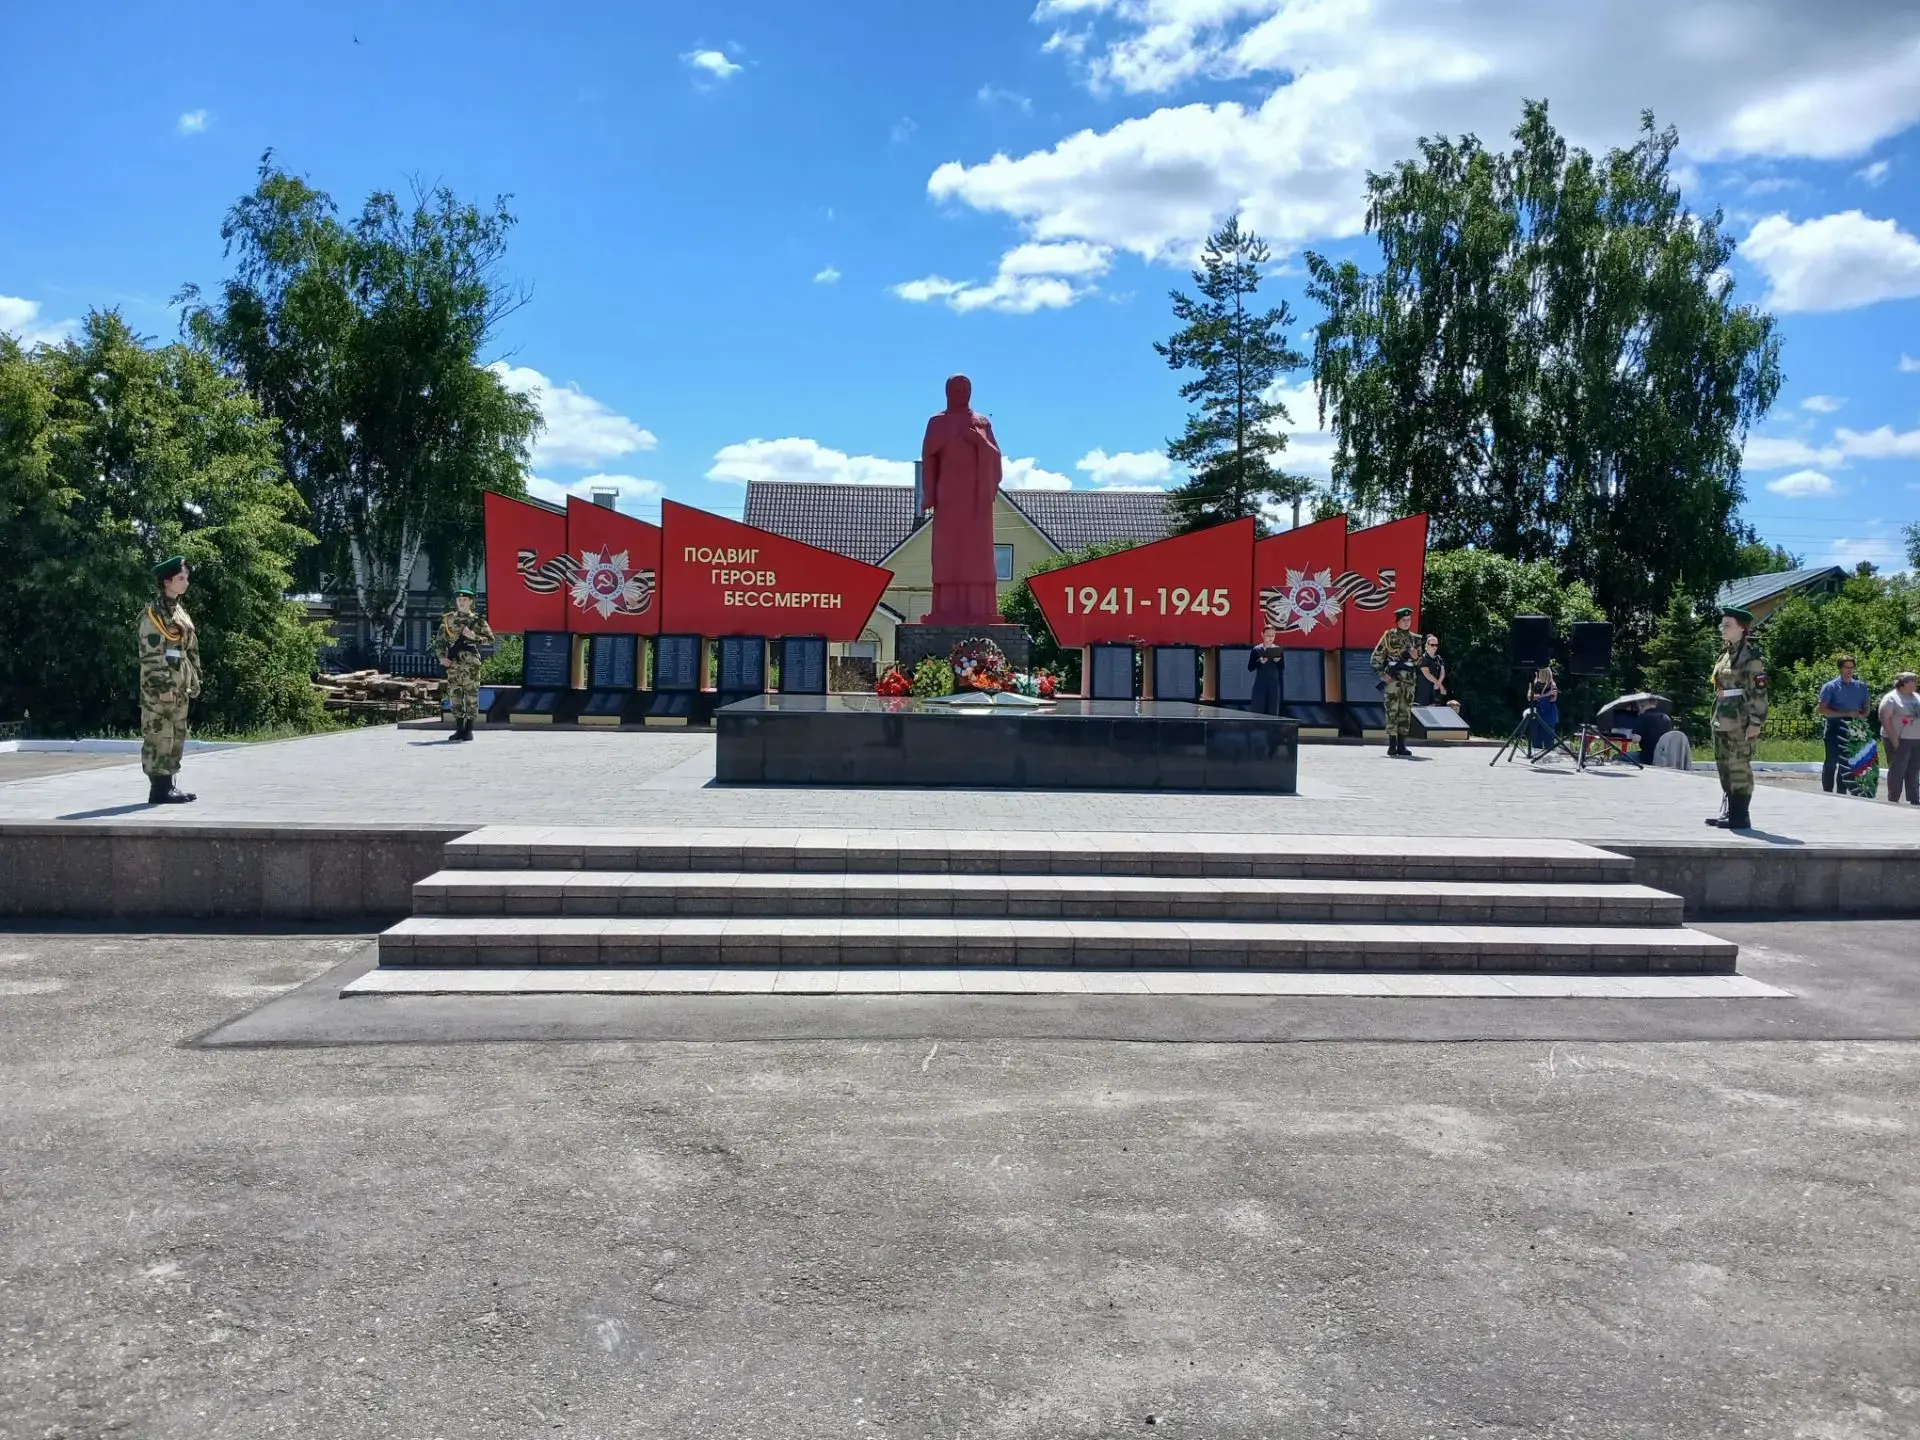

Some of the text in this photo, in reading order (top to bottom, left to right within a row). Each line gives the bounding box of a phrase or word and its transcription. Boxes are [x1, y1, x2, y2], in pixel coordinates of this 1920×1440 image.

[684, 547, 760, 566] ПОДВИГ
[711, 569, 776, 586] ГЕРОЕВ
[724, 590, 842, 609] БЕССМЕРТЕН
